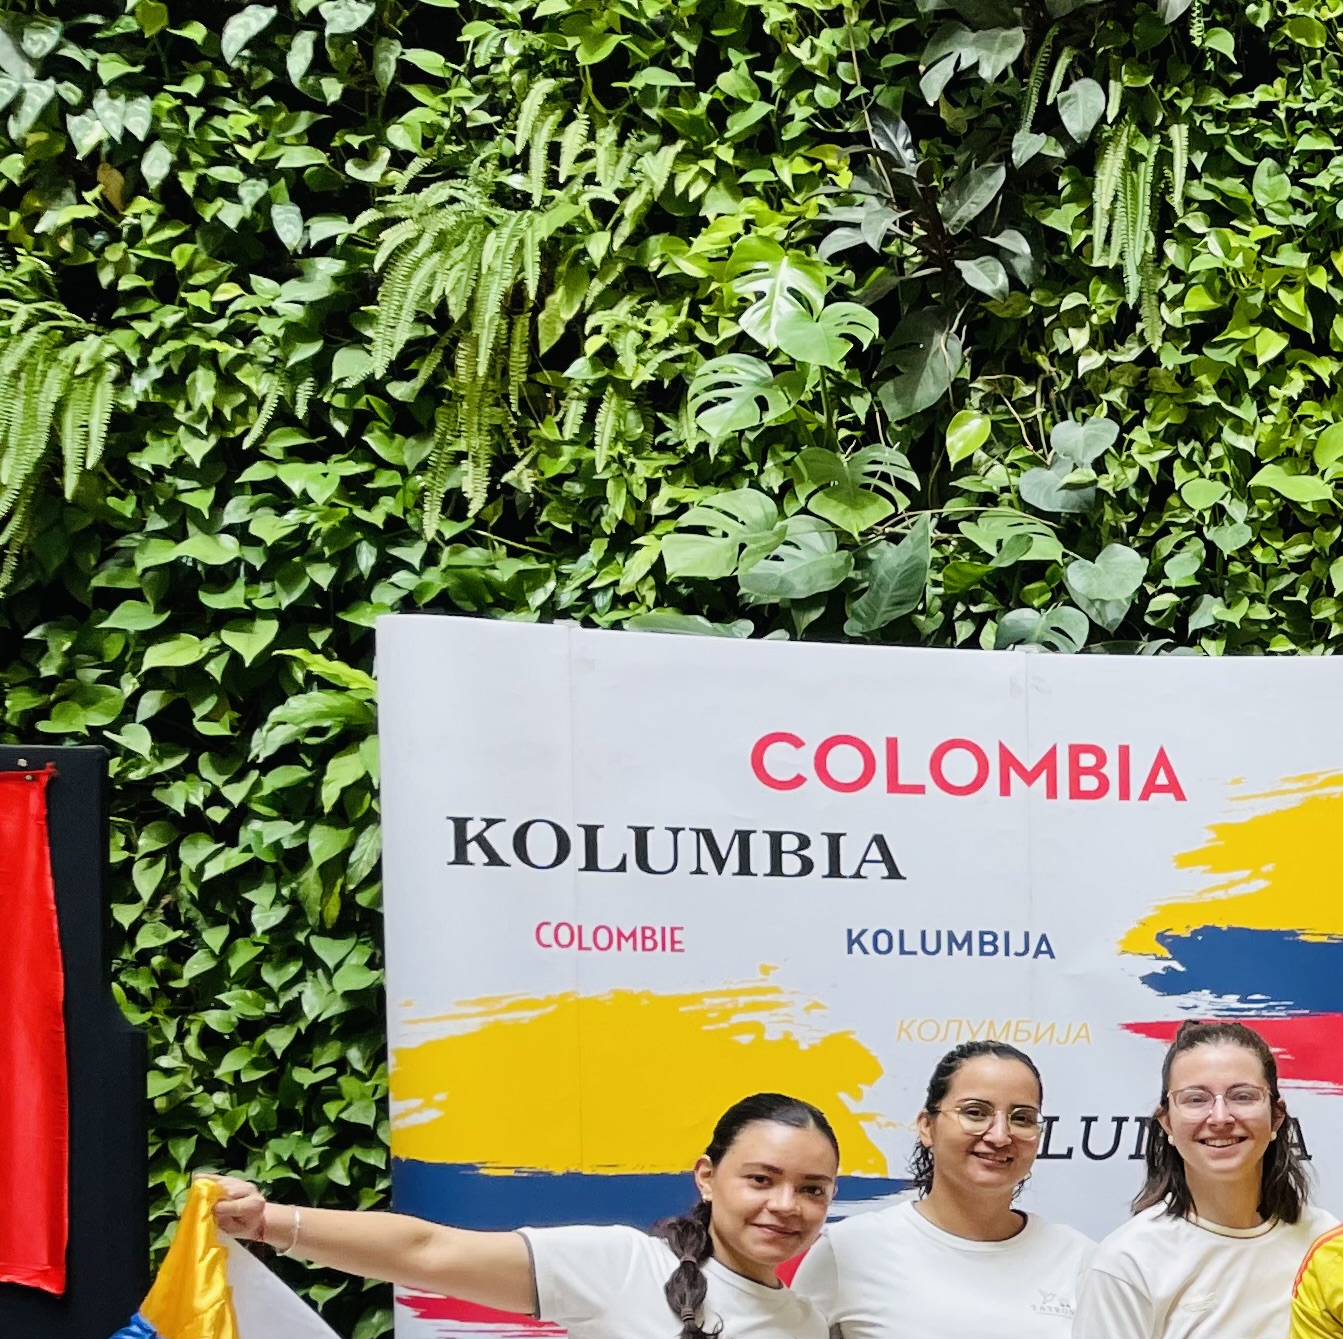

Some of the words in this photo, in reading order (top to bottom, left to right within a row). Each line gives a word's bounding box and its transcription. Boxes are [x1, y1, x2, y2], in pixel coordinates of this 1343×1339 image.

[751, 731, 1187, 801] COLOMBIA
[446, 816, 907, 880] KOLUMBIA
[535, 921, 685, 953] COLOMBIE
[846, 928, 1056, 961] KOLUMBIJA
